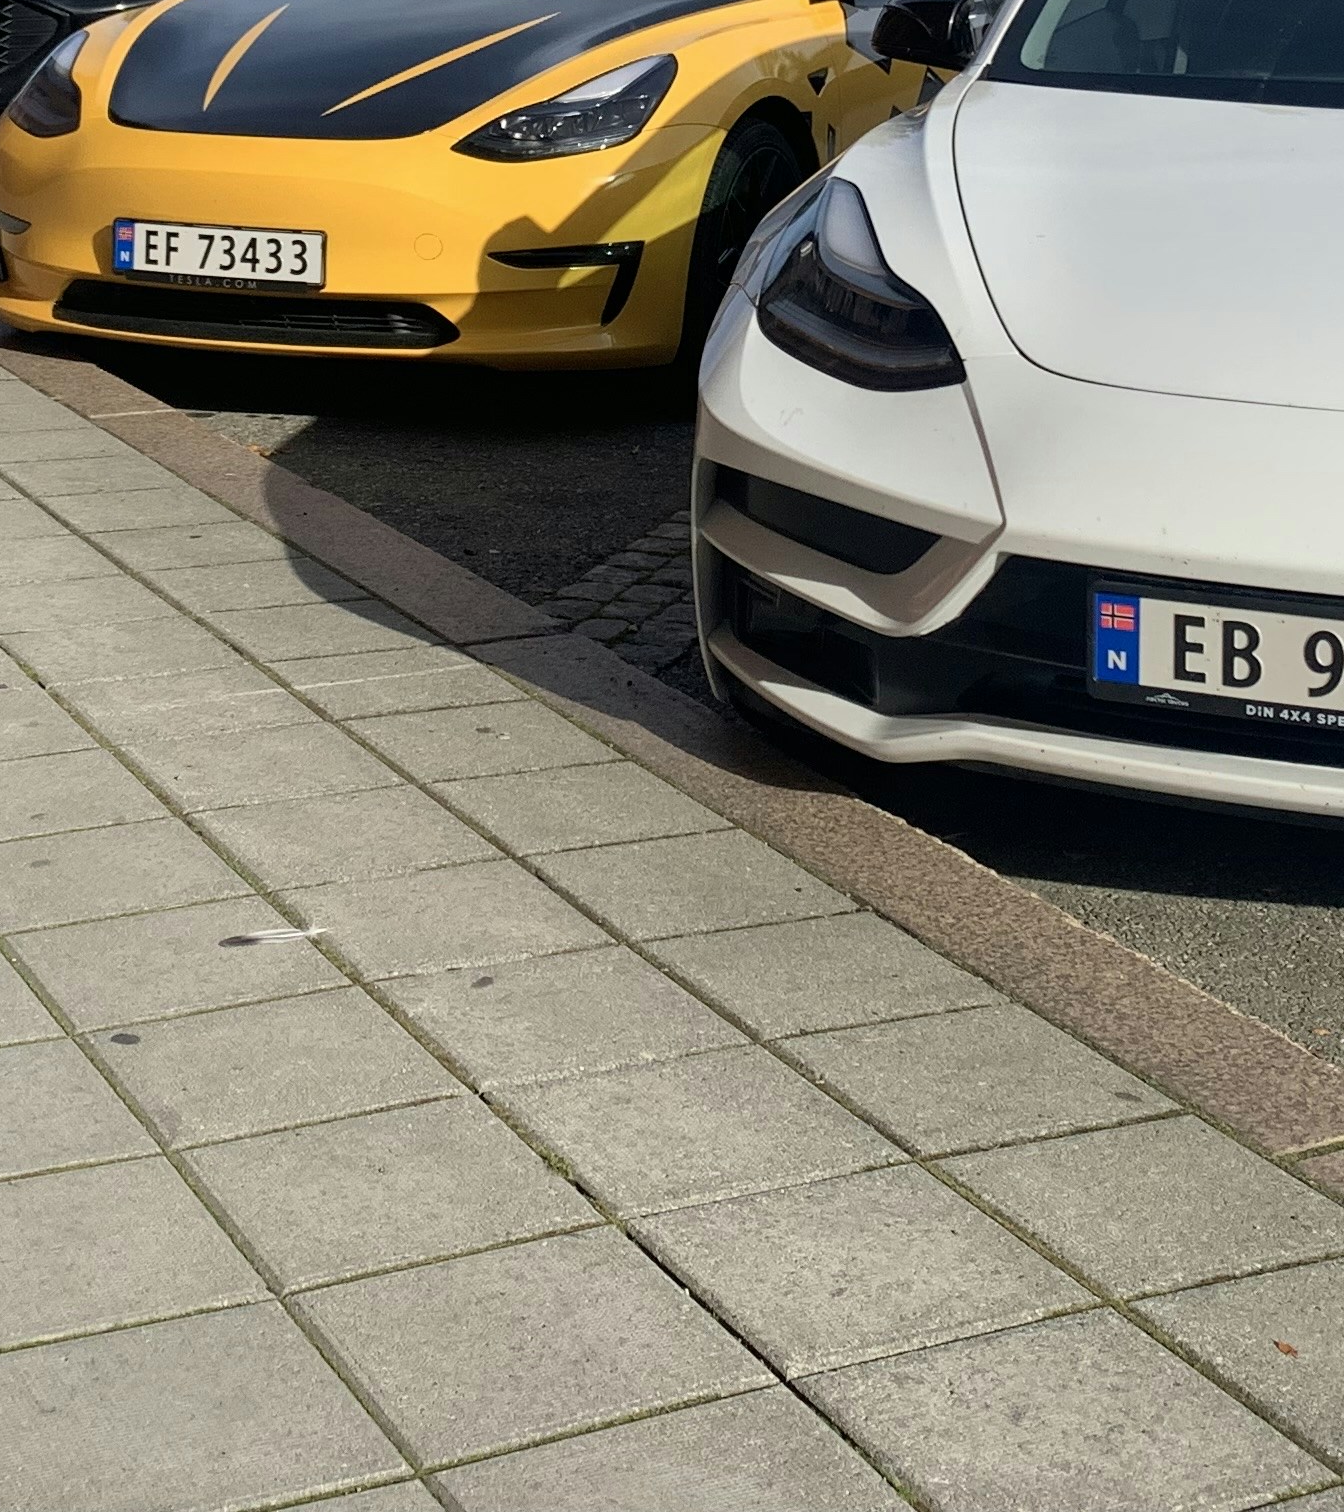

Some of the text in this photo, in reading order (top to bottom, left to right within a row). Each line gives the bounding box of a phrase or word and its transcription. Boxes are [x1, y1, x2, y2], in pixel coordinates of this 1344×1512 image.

[120, 251, 130, 263] N
[145, 230, 308, 276] EF 73433
[168, 274, 257, 289] TESLA.COM
[1107, 650, 1127, 672] N
[1172, 614, 1263, 688] EB
[1245, 704, 1274, 719] DIN
[1279, 709, 1311, 723] 4X4
